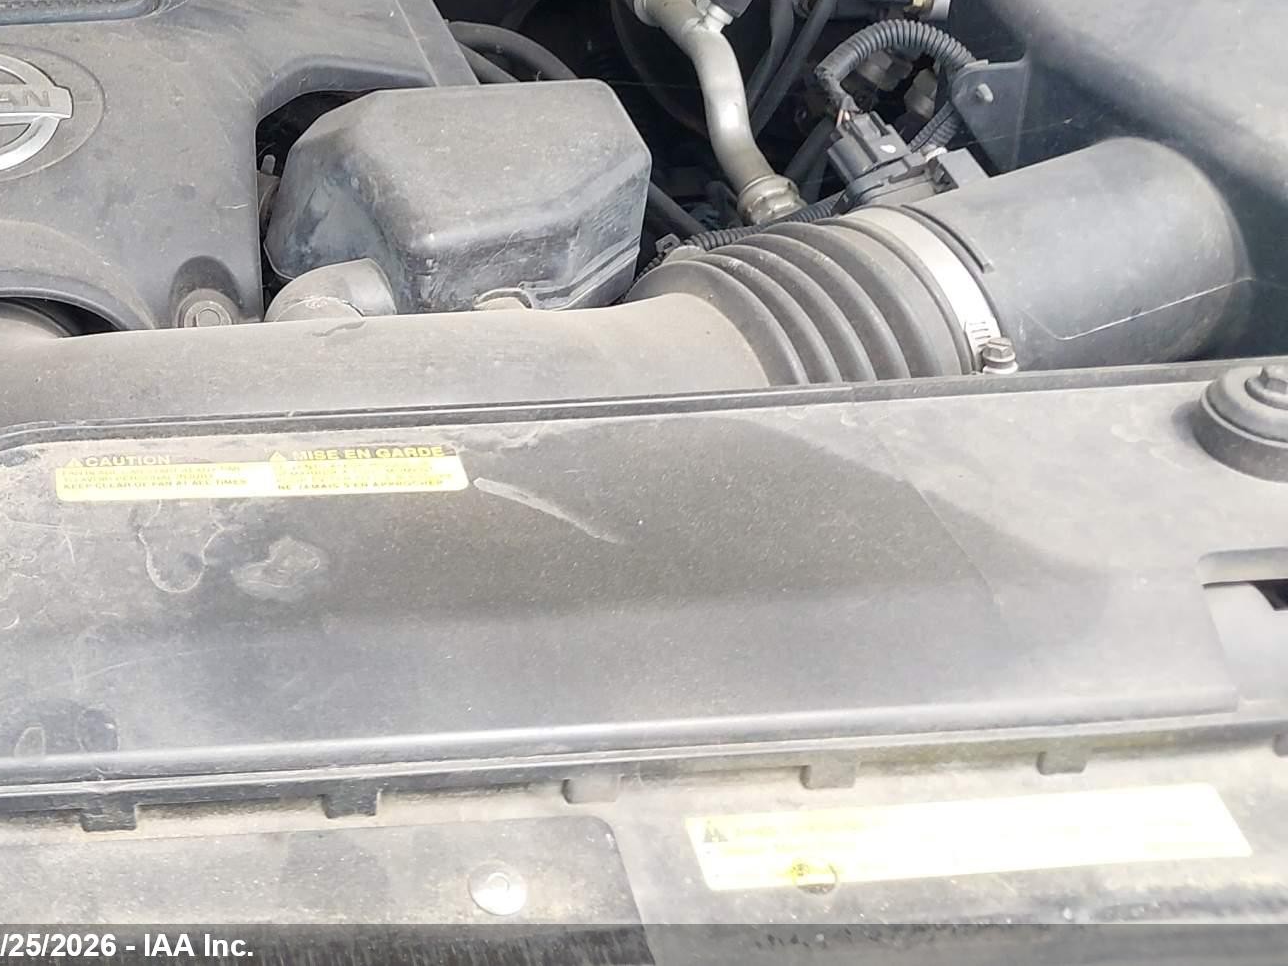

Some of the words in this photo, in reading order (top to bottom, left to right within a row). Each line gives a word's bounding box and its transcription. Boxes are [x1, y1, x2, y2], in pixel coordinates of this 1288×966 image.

[292, 450, 339, 461] MISE
[345, 448, 371, 459] EN
[375, 446, 445, 459] GARDE
[85, 455, 171, 467] CAUTION
